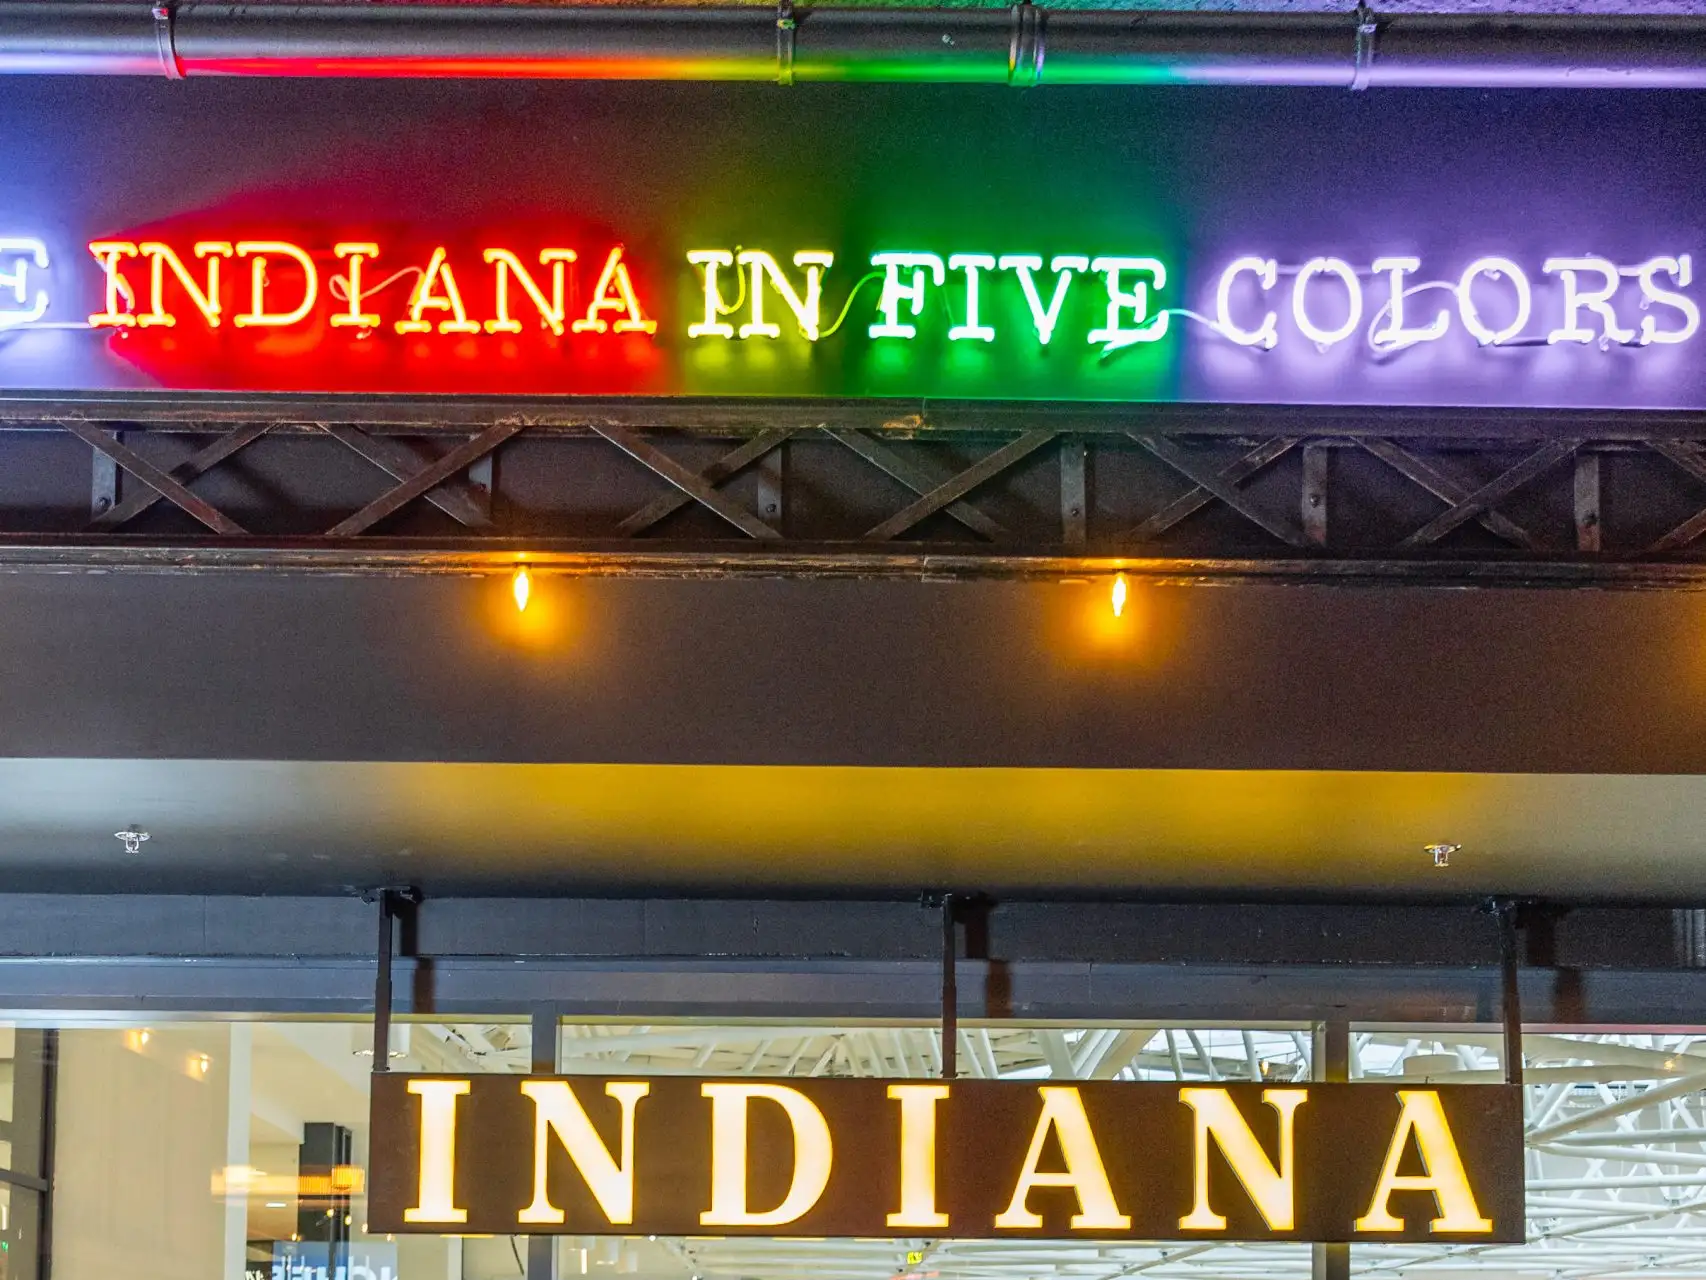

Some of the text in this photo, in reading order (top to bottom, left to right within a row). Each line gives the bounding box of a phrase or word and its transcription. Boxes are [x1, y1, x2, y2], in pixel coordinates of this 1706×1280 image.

[89, 241, 658, 334] INDIANA
[687, 248, 834, 340] IN
[868, 250, 1170, 344] FIVE
[1215, 254, 1702, 348] COLORS
[403, 1079, 1494, 1233] INDIANA
